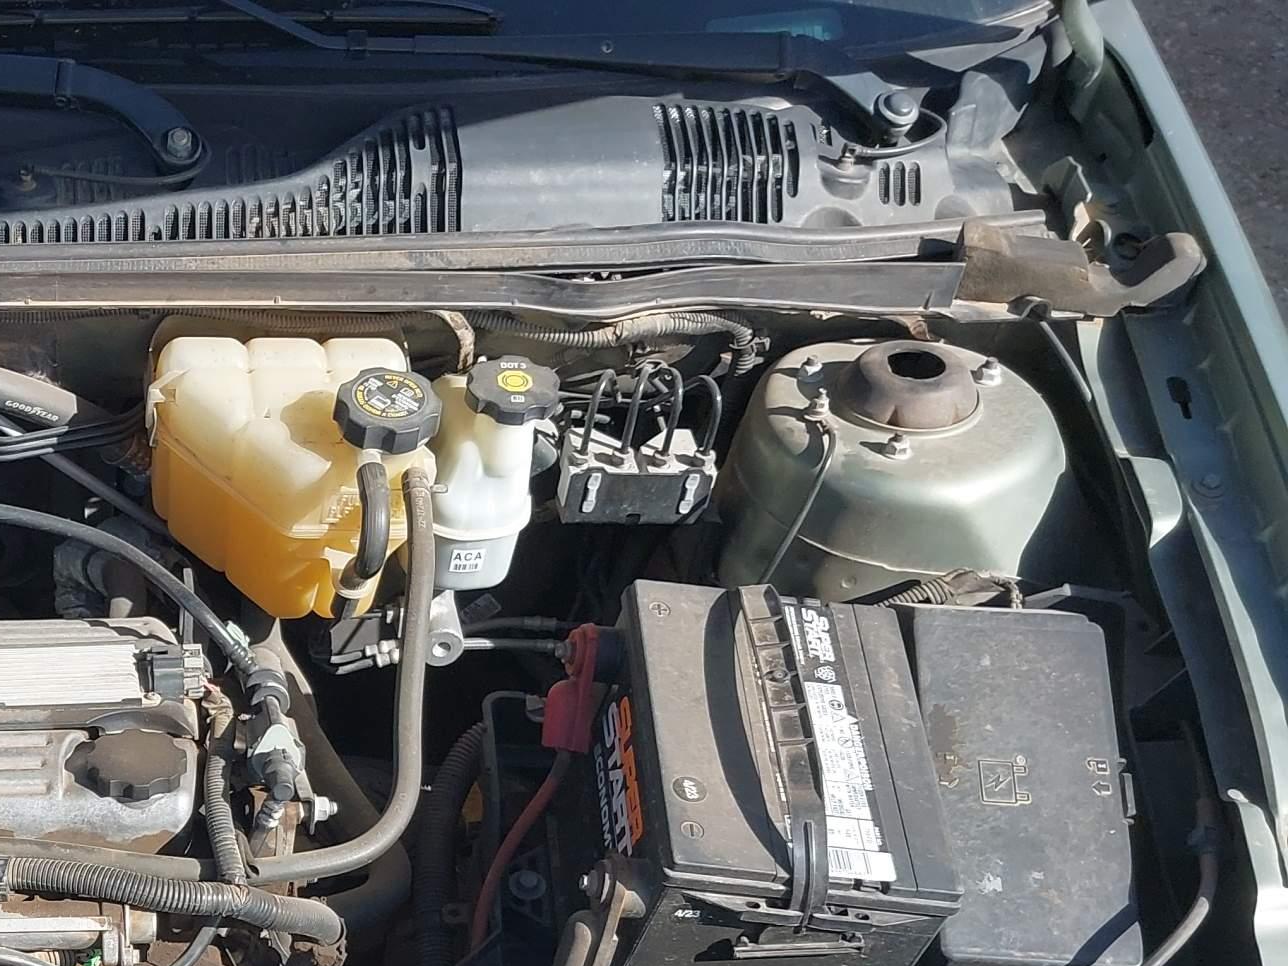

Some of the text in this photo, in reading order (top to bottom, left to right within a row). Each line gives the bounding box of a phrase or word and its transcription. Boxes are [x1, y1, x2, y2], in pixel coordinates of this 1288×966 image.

[5, 400, 59, 422] GOODYEAR
[453, 551, 482, 562] ACA
[801, 607, 823, 659] START
[815, 616, 836, 663] SUPER
[603, 702, 633, 857] START
[620, 696, 643, 848] SUPER
[682, 779, 700, 800] 4/23
[593, 743, 613, 849] ECONOM
[674, 909, 700, 918] 4/23
